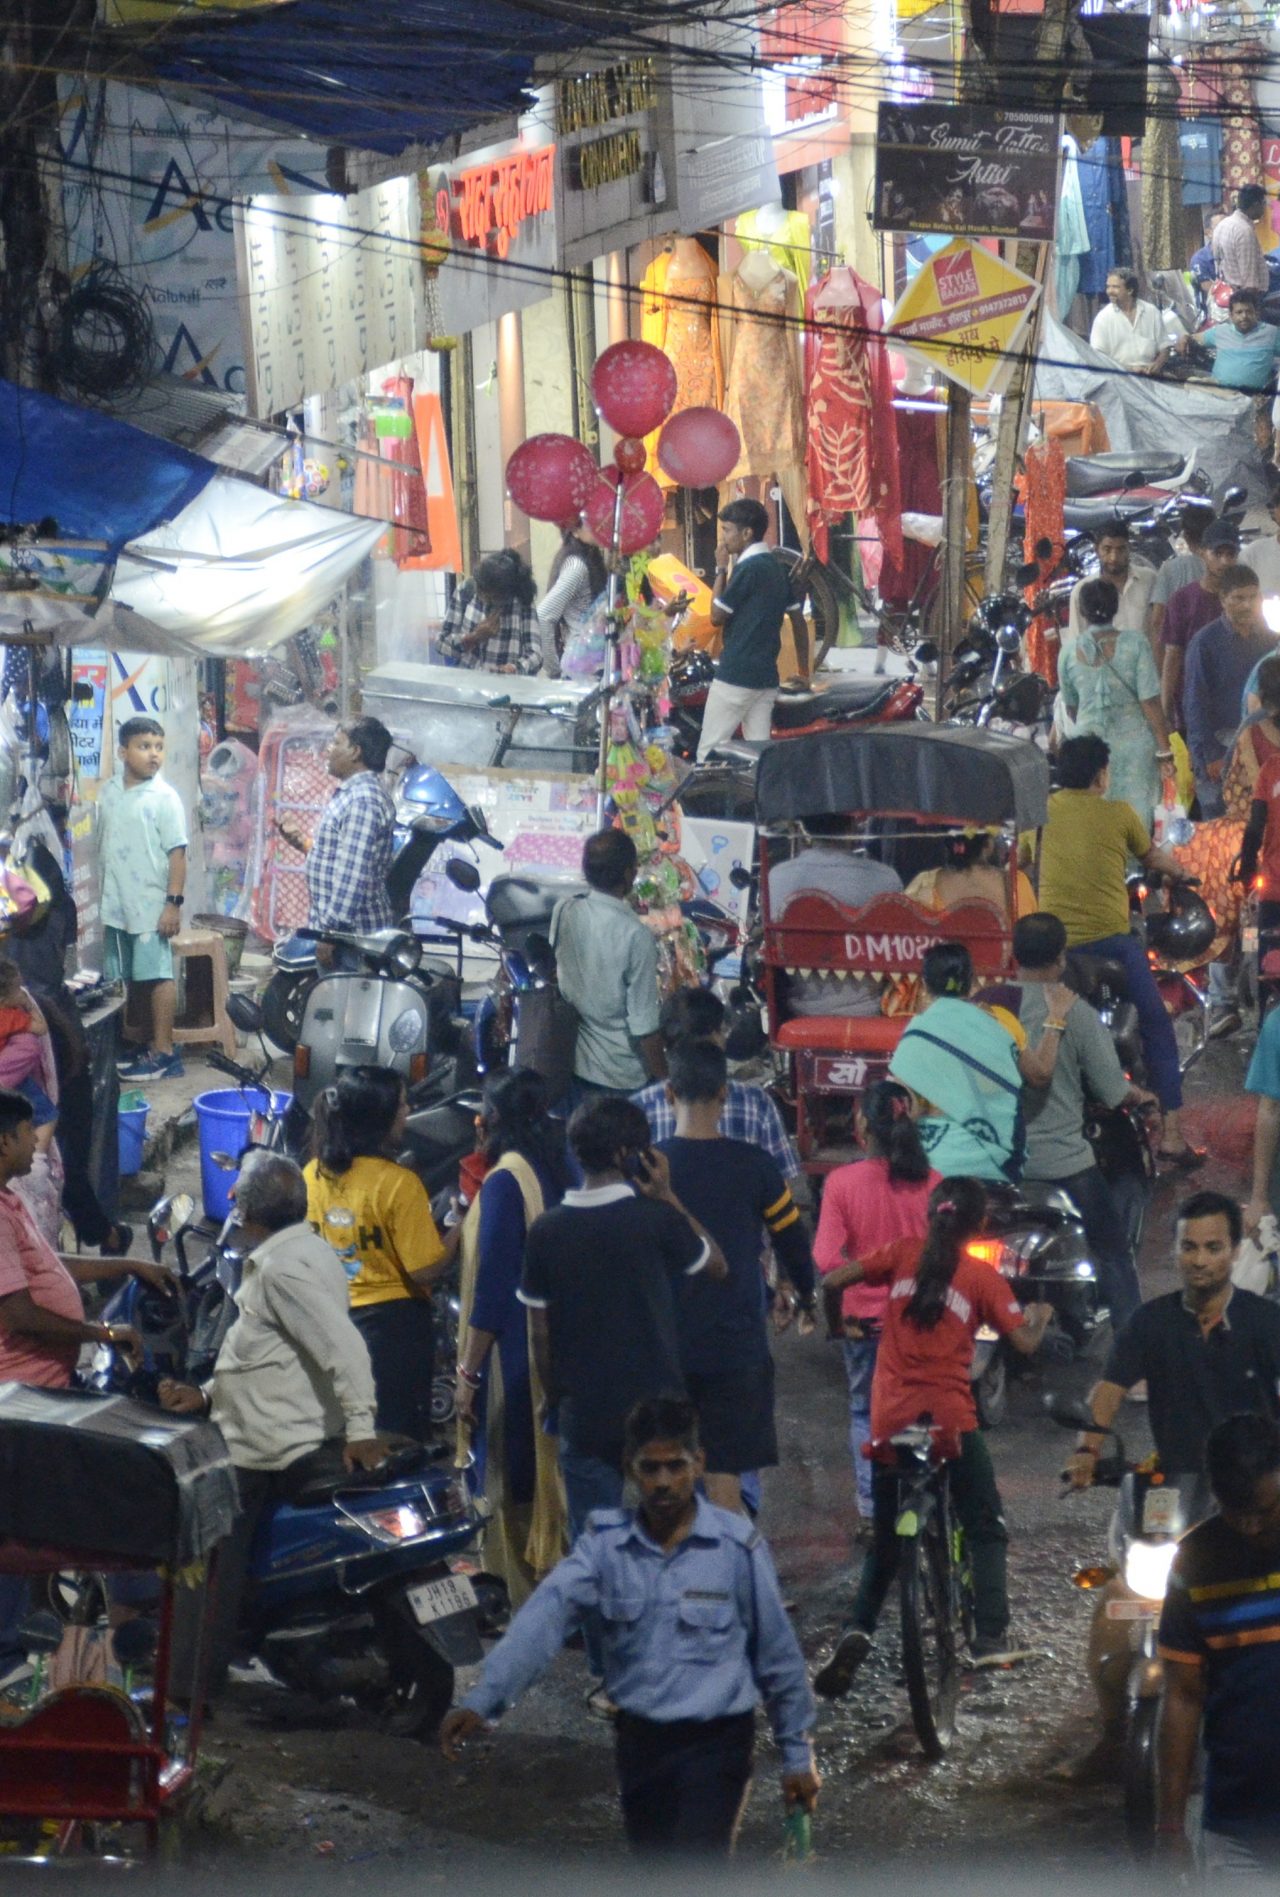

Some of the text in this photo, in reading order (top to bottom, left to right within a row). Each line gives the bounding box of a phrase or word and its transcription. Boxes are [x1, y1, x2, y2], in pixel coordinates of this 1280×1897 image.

[924, 121, 991, 152] Sumit
[945, 153, 1021, 185] Artist
[938, 269, 975, 290] STYLE
